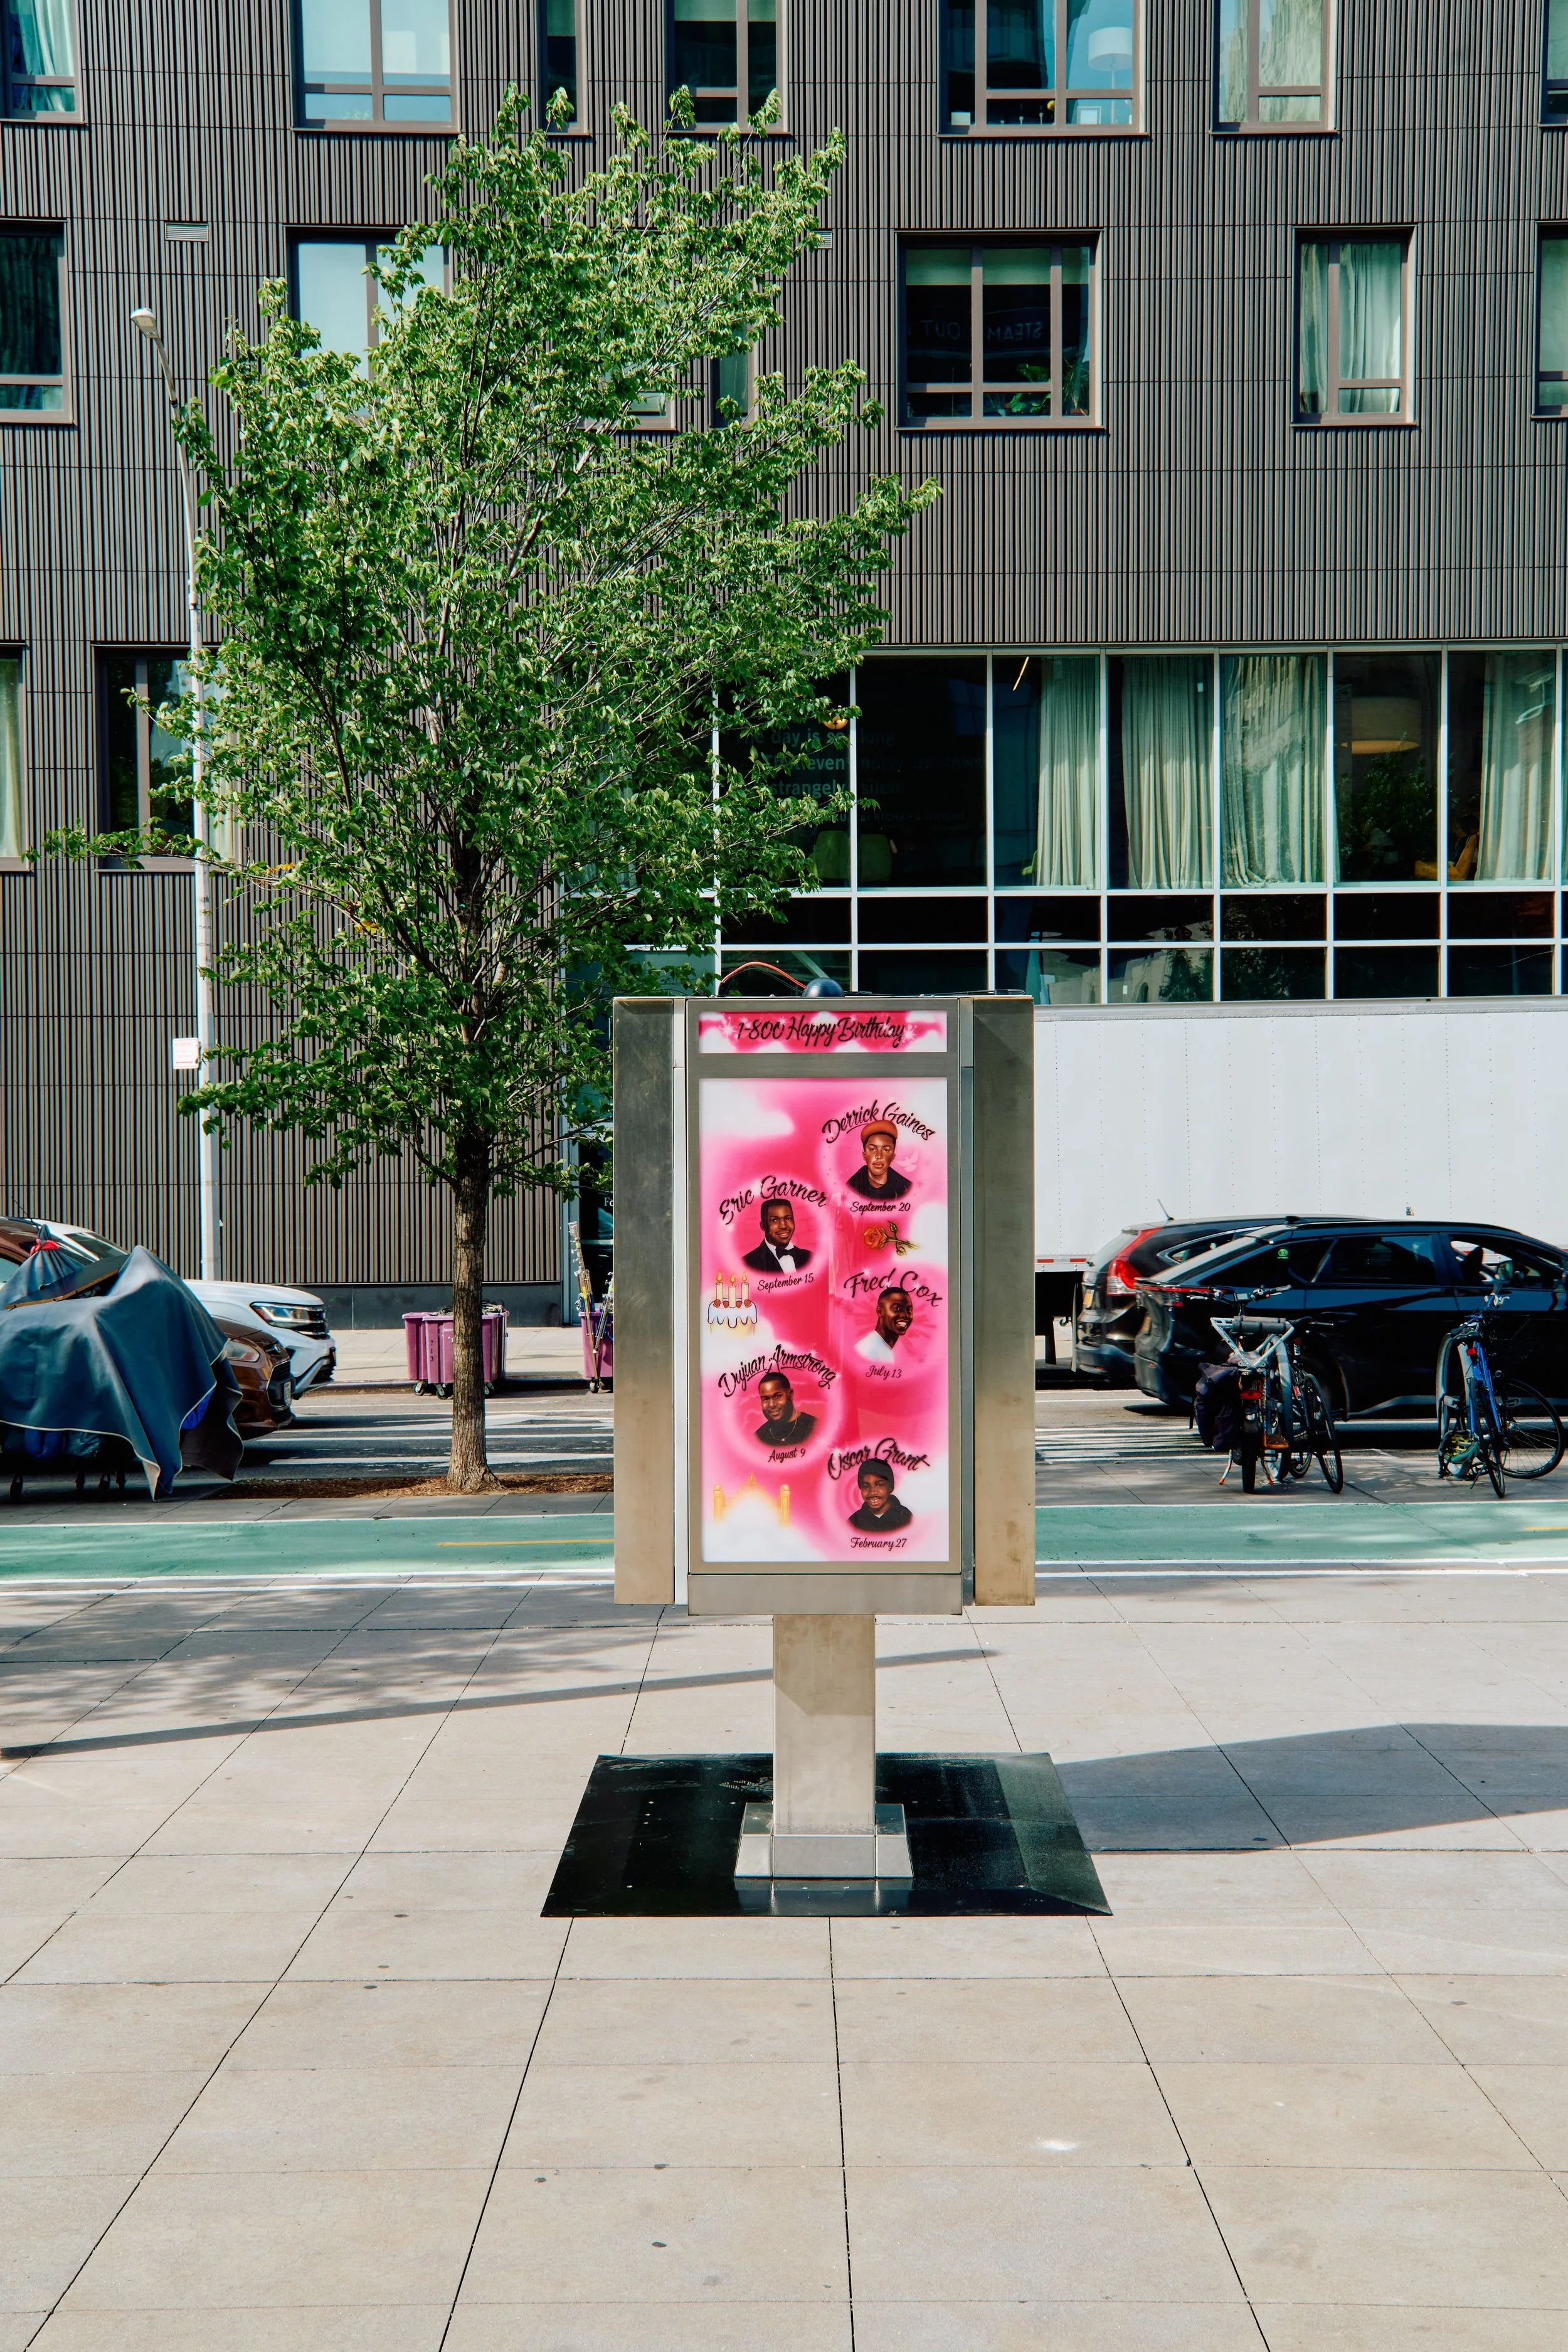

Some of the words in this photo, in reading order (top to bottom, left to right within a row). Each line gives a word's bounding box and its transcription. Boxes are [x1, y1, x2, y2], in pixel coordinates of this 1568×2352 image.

[771, 729, 800, 748] day
[808, 758, 845, 771] even
[736, 1019, 784, 1040] 1-800
[786, 1015, 837, 1047] Happy
[837, 1016, 906, 1049] Birthday
[822, 1099, 879, 1144] Derrick
[882, 1102, 936, 1141] Gaines
[719, 1189, 755, 1226] Eric
[760, 1175, 828, 1207] Garner
[850, 1201, 896, 1216] September
[898, 1202, 911, 1212] 20
[757, 1275, 803, 1293] September
[804, 1273, 814, 1283] 15
[844, 1268, 897, 1298] Fred
[899, 1271, 943, 1307] Cox
[718, 1355, 769, 1397] Dujuan
[766, 1343, 837, 1390] Armstrong
[866, 1365, 891, 1380] July
[891, 1369, 903, 1379] 13
[768, 1448, 798, 1463] August
[800, 1448, 806, 1458] 9
[828, 1445, 871, 1480] Oscar
[874, 1438, 930, 1471] Grant
[850, 1537, 896, 1552] February
[895, 1538, 907, 1548] 27
